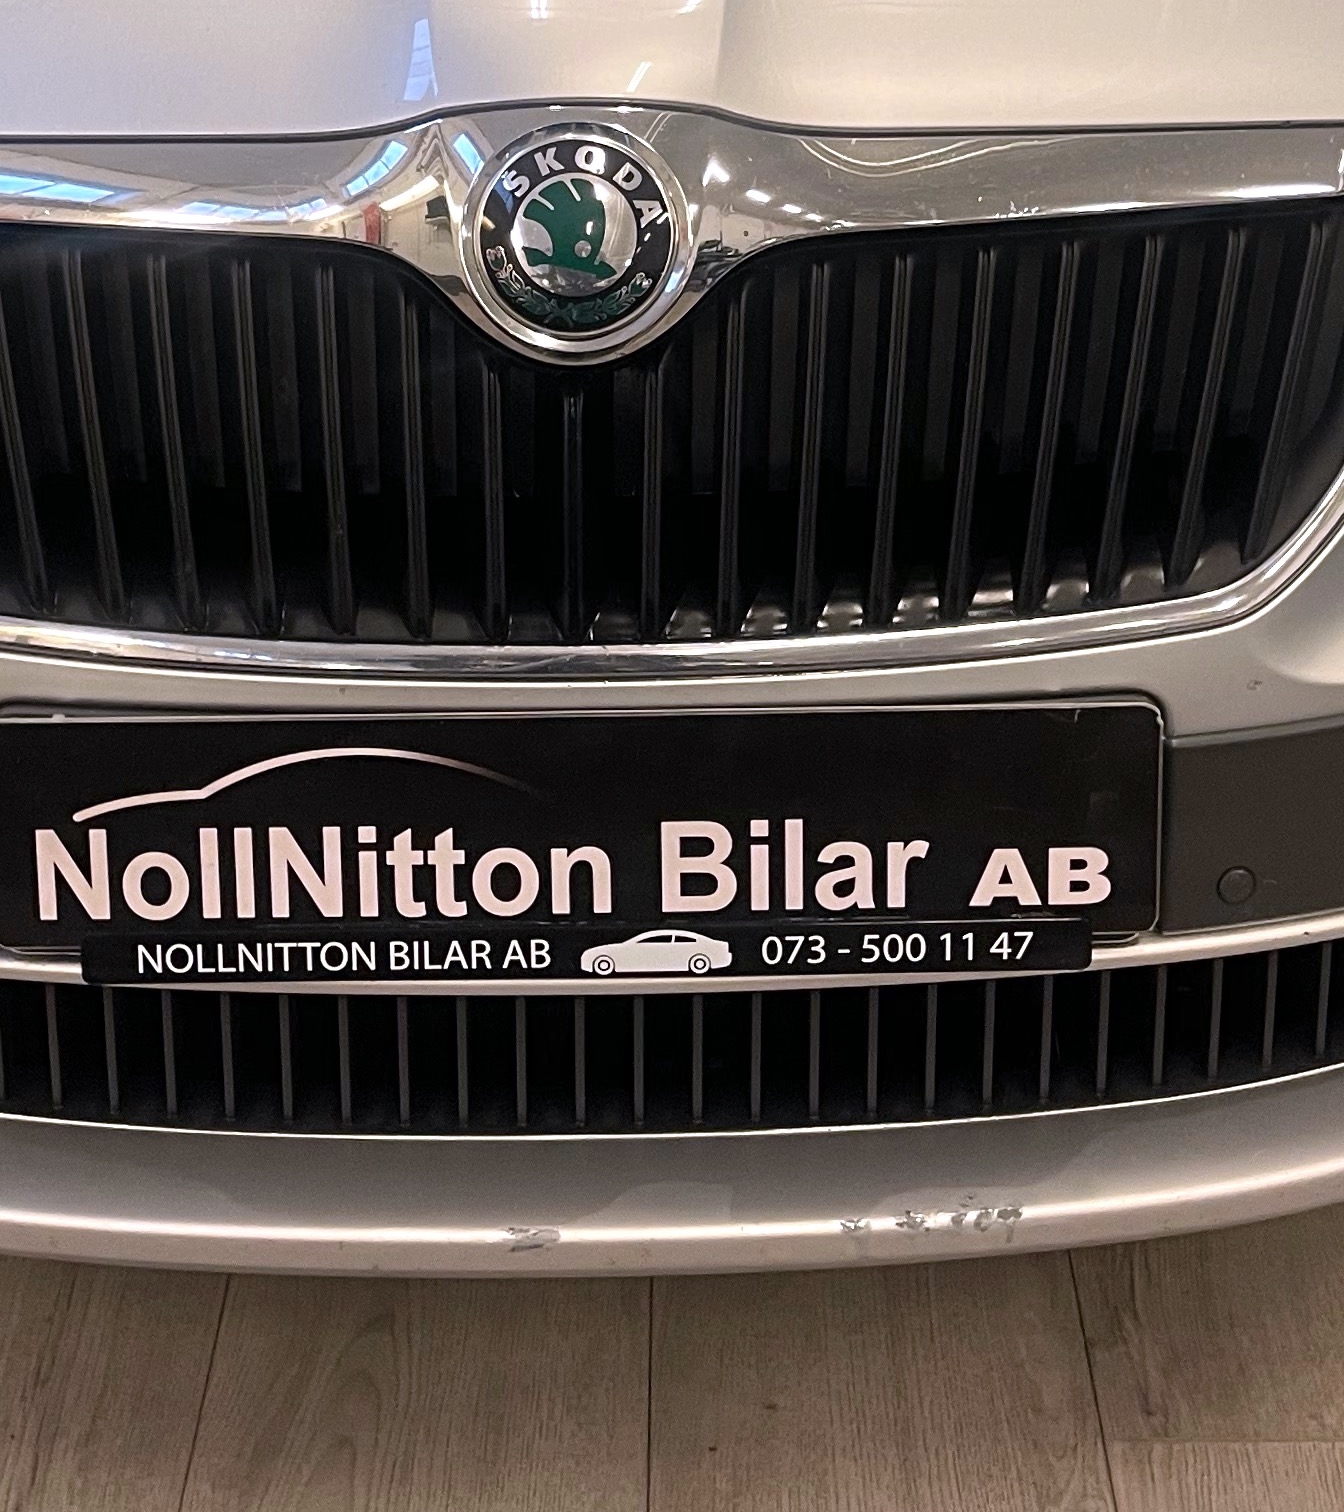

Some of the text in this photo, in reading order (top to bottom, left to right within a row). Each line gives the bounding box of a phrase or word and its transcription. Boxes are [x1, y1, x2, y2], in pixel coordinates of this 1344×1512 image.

[35, 819, 1112, 922] NollNitton Bilar AB
[137, 939, 552, 974] NOLLNITTON BILAR AB
[761, 935, 827, 965] 073
[861, 933, 927, 963] 500
[939, 932, 975, 961] 11
[989, 931, 1034, 960] 47
